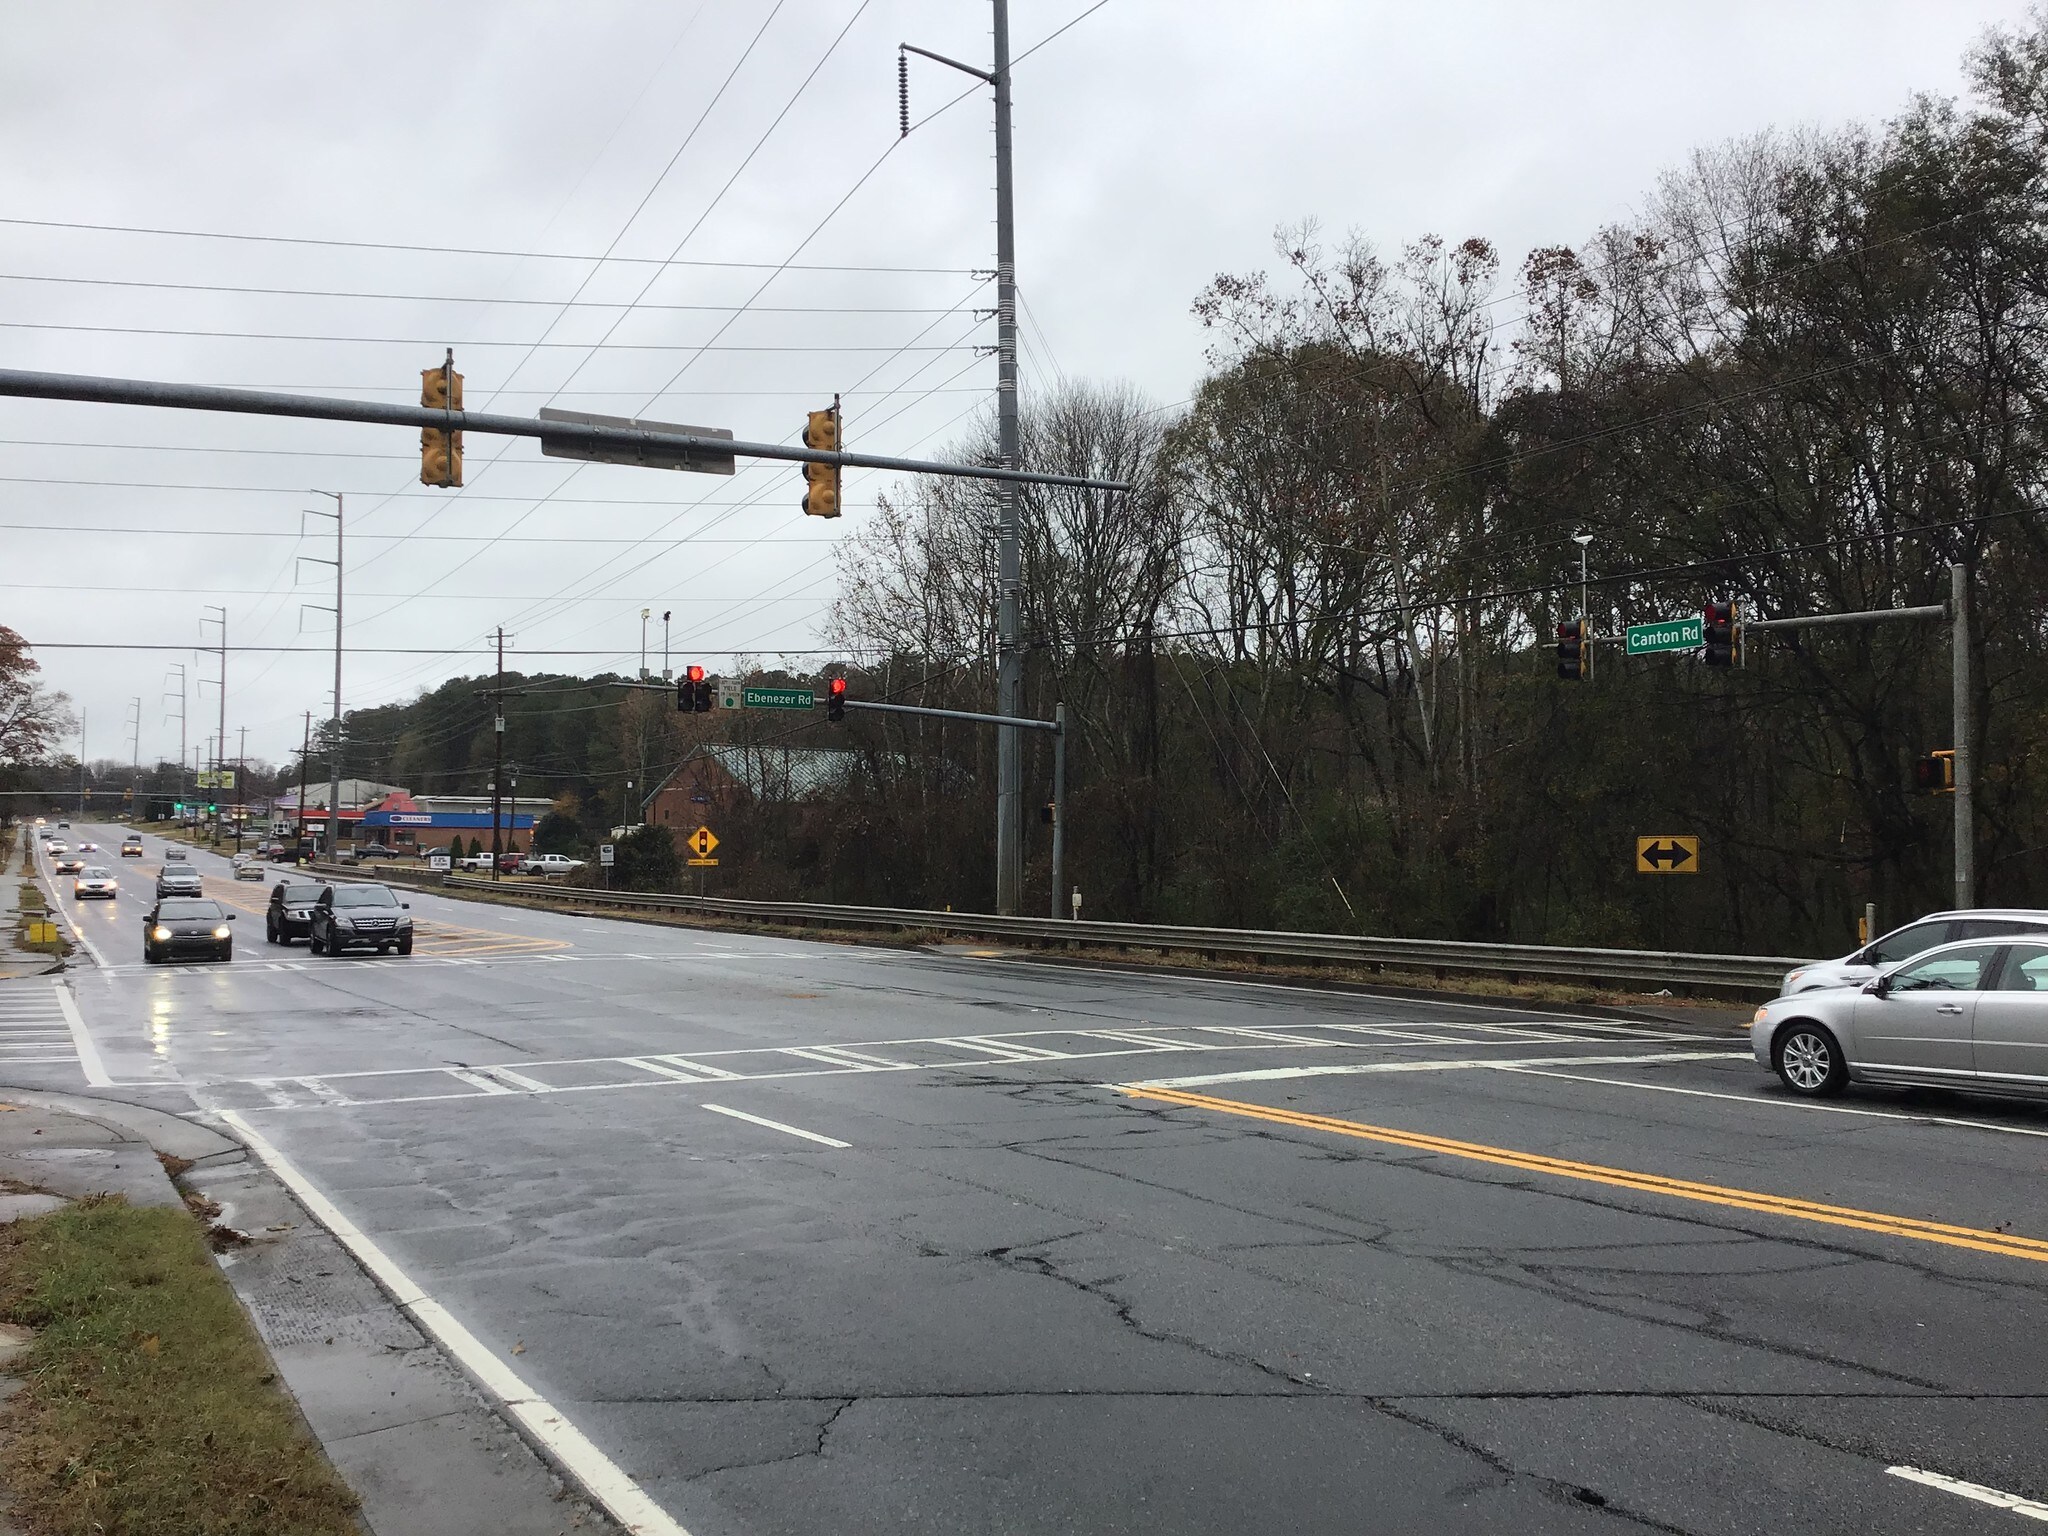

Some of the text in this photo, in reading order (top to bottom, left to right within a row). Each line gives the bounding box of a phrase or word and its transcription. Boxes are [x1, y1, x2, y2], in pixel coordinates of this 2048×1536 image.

[1631, 626, 1699, 647] Canton Rd
[747, 692, 796, 704] Ebenezer
[798, 694, 811, 705] Rd
